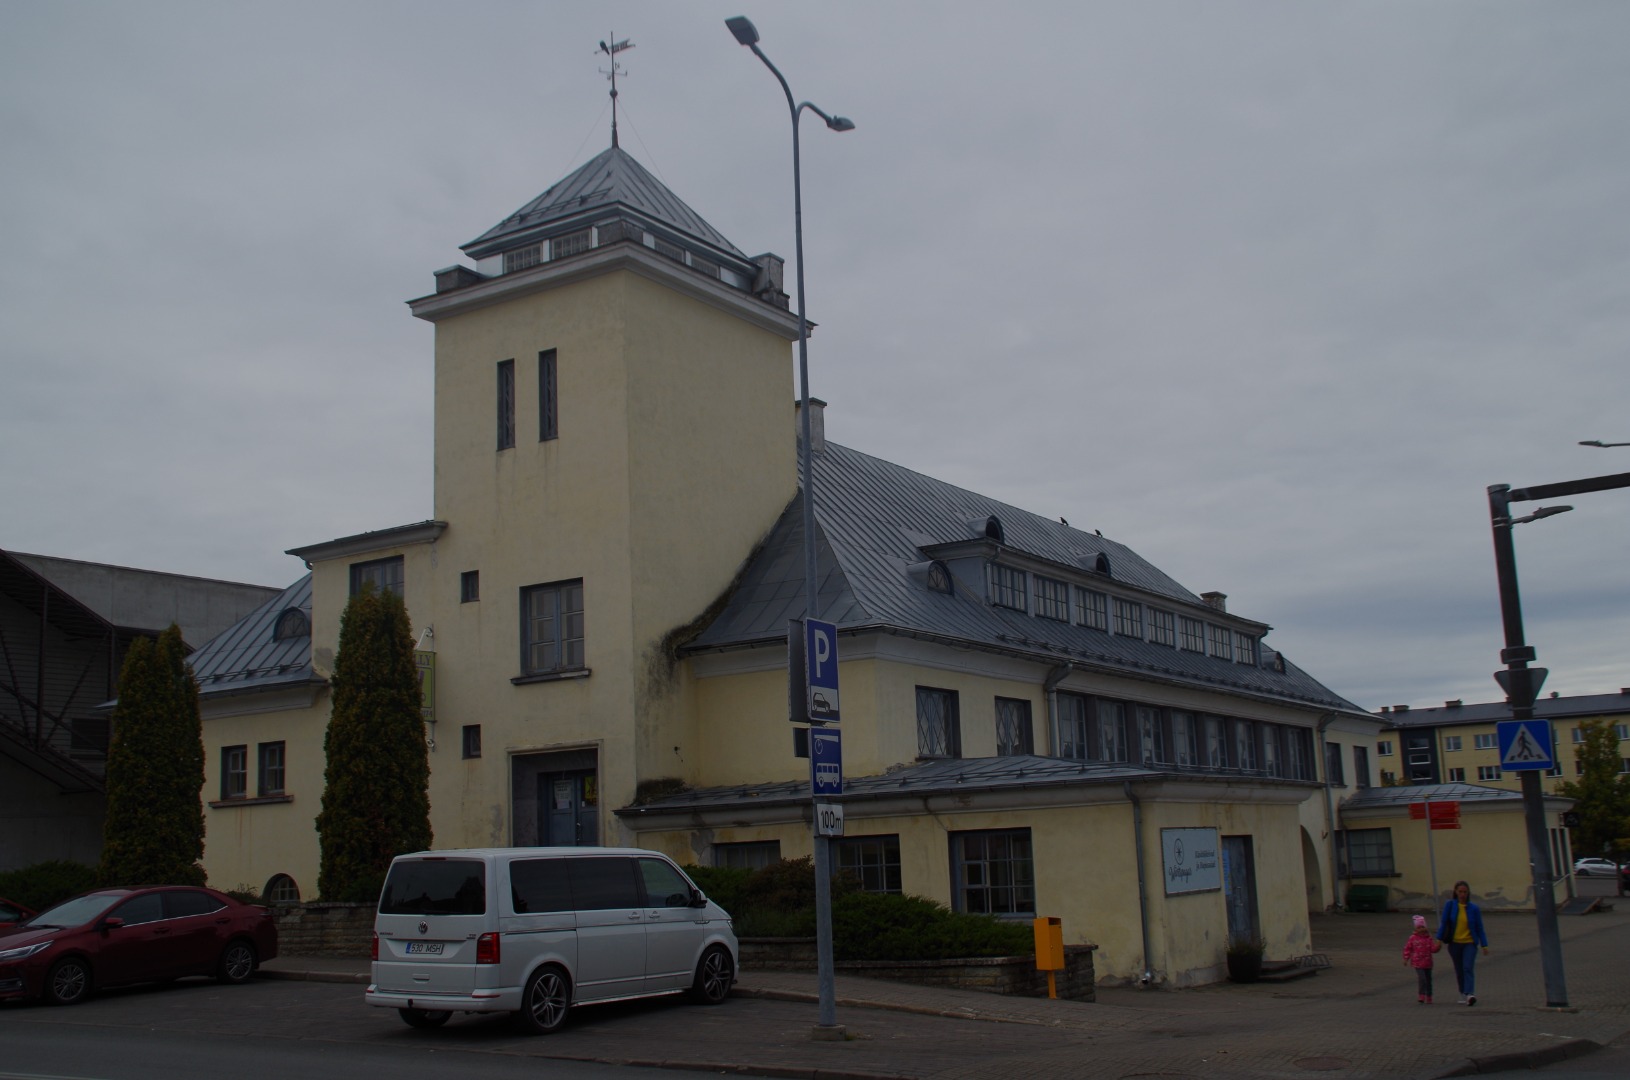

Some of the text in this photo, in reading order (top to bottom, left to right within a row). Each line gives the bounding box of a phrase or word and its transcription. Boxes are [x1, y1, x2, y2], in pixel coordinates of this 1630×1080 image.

[814, 629, 830, 678] P
[820, 809, 842, 829] 100m
[411, 943, 442, 953] 530 MSH
